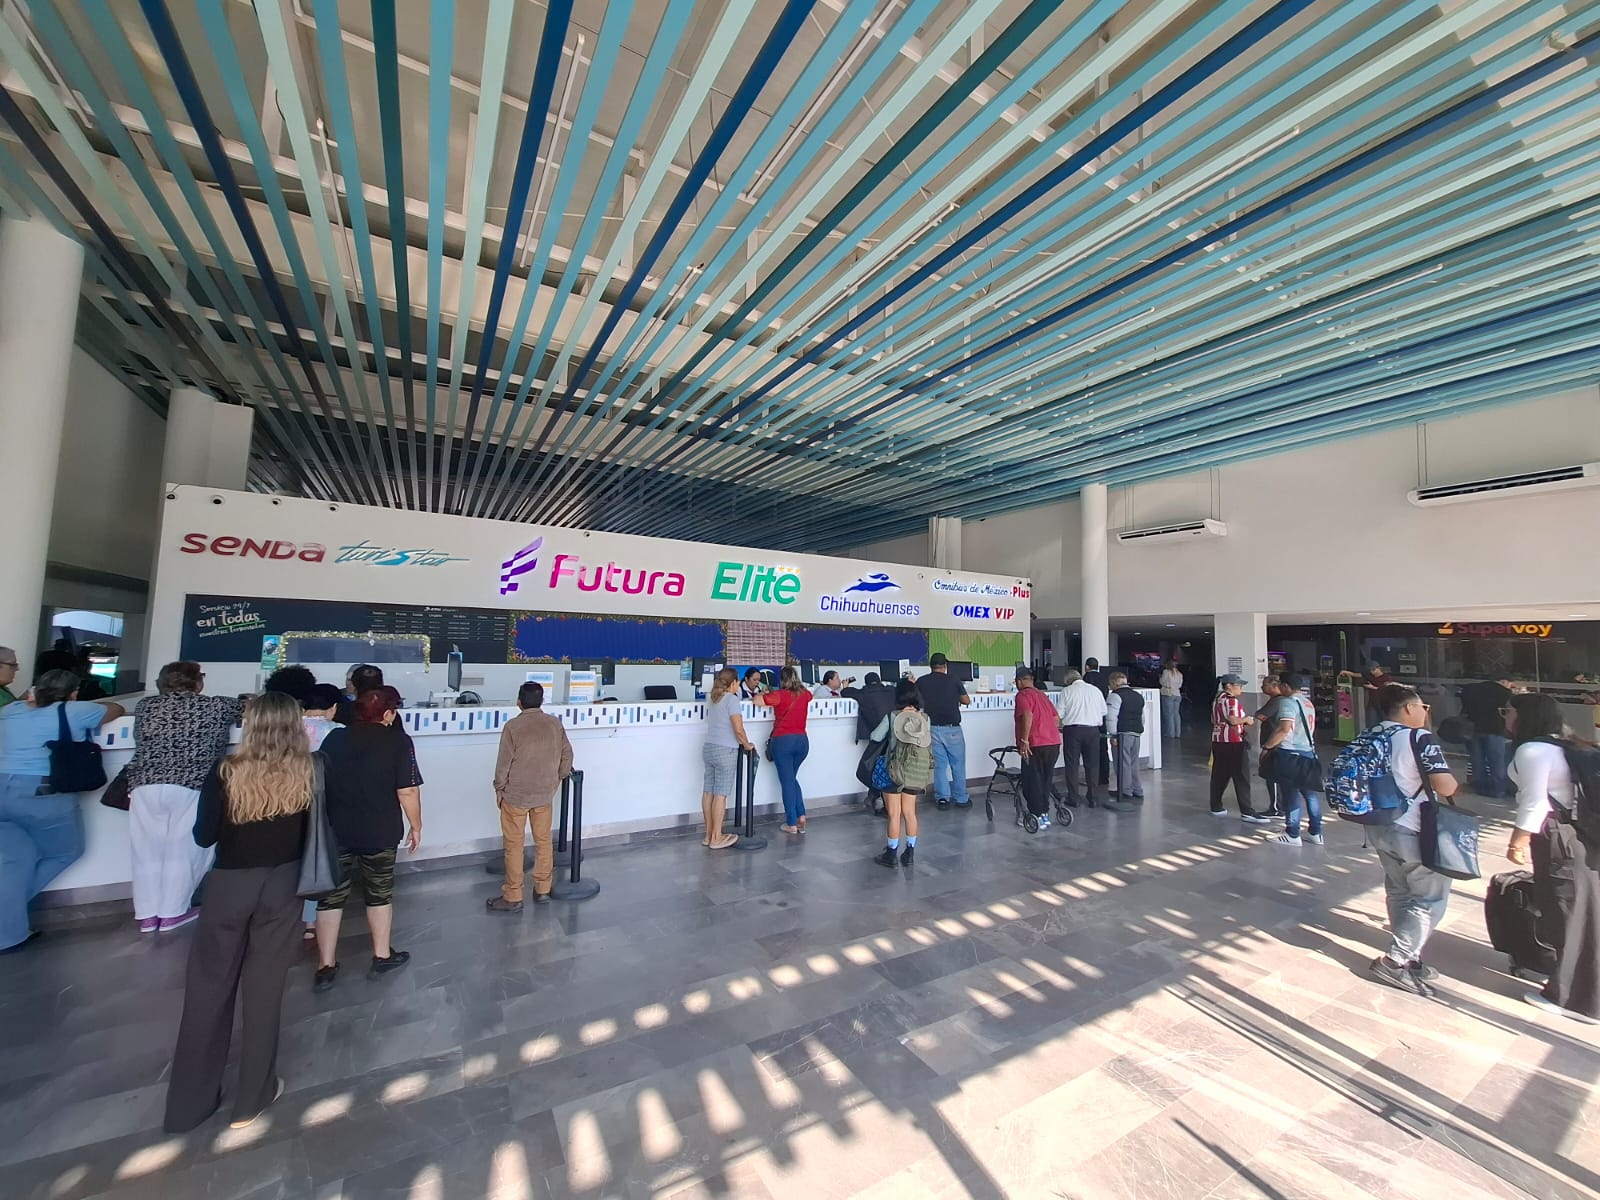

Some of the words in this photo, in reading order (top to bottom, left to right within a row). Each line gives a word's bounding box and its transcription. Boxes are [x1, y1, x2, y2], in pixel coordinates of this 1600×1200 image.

[549, 554, 685, 597] Futura
[711, 561, 801, 605] Elite
[933, 579, 967, 592] Omnibus
[969, 582, 979, 593] de
[820, 595, 920, 616] Chihuahuenses
[953, 604, 990, 619] OMEX
[994, 607, 1015, 620] VIP
[196, 616, 216, 628] en
[217, 609, 261, 626] todas
